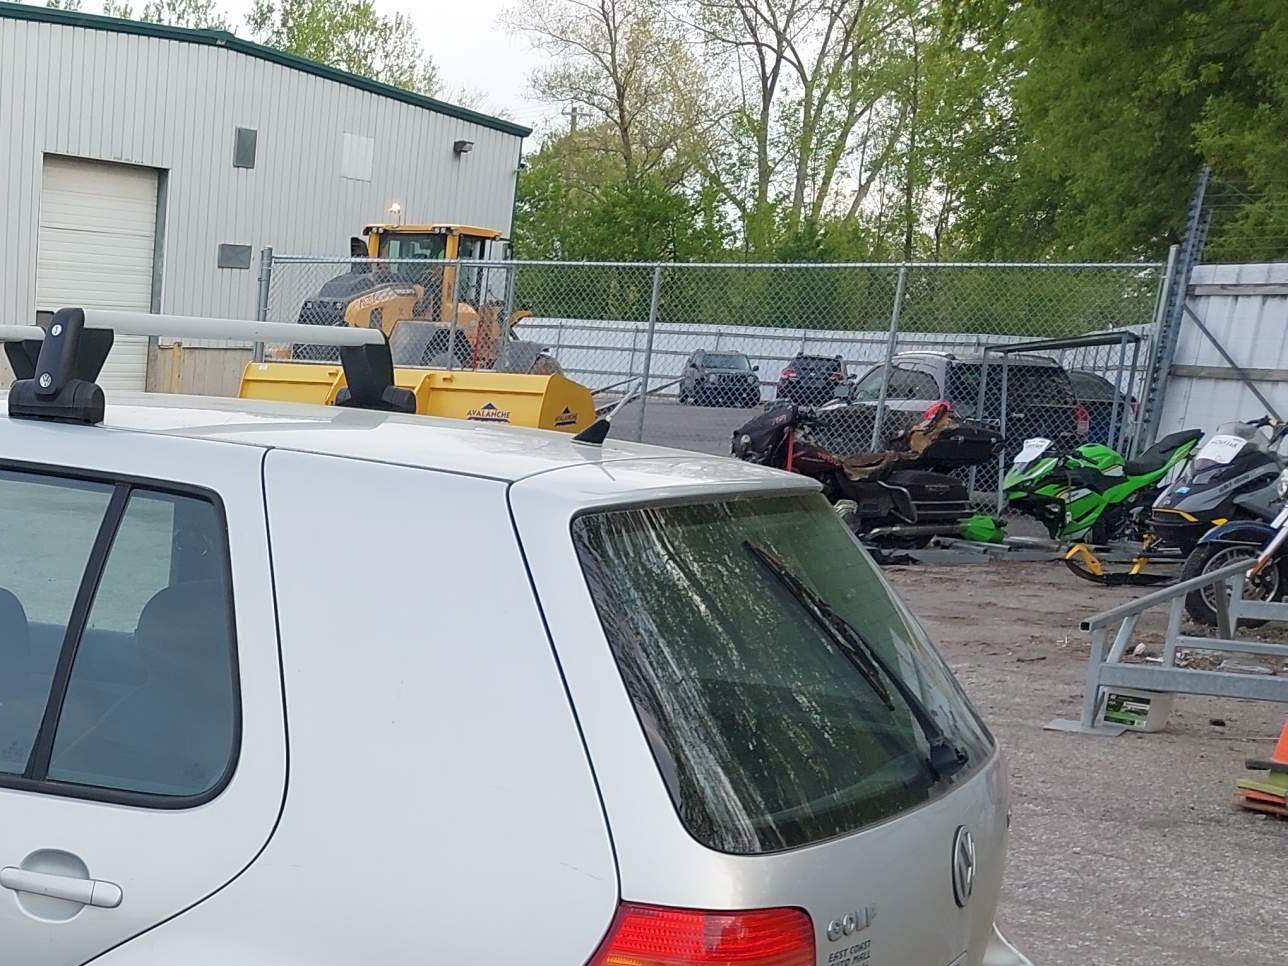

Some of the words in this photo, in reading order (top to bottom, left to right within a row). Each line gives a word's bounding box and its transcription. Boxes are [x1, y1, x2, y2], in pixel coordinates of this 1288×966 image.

[467, 409, 511, 419] AVALANCHE
[828, 948, 849, 963] EAST
[852, 950, 871, 965] MALL
